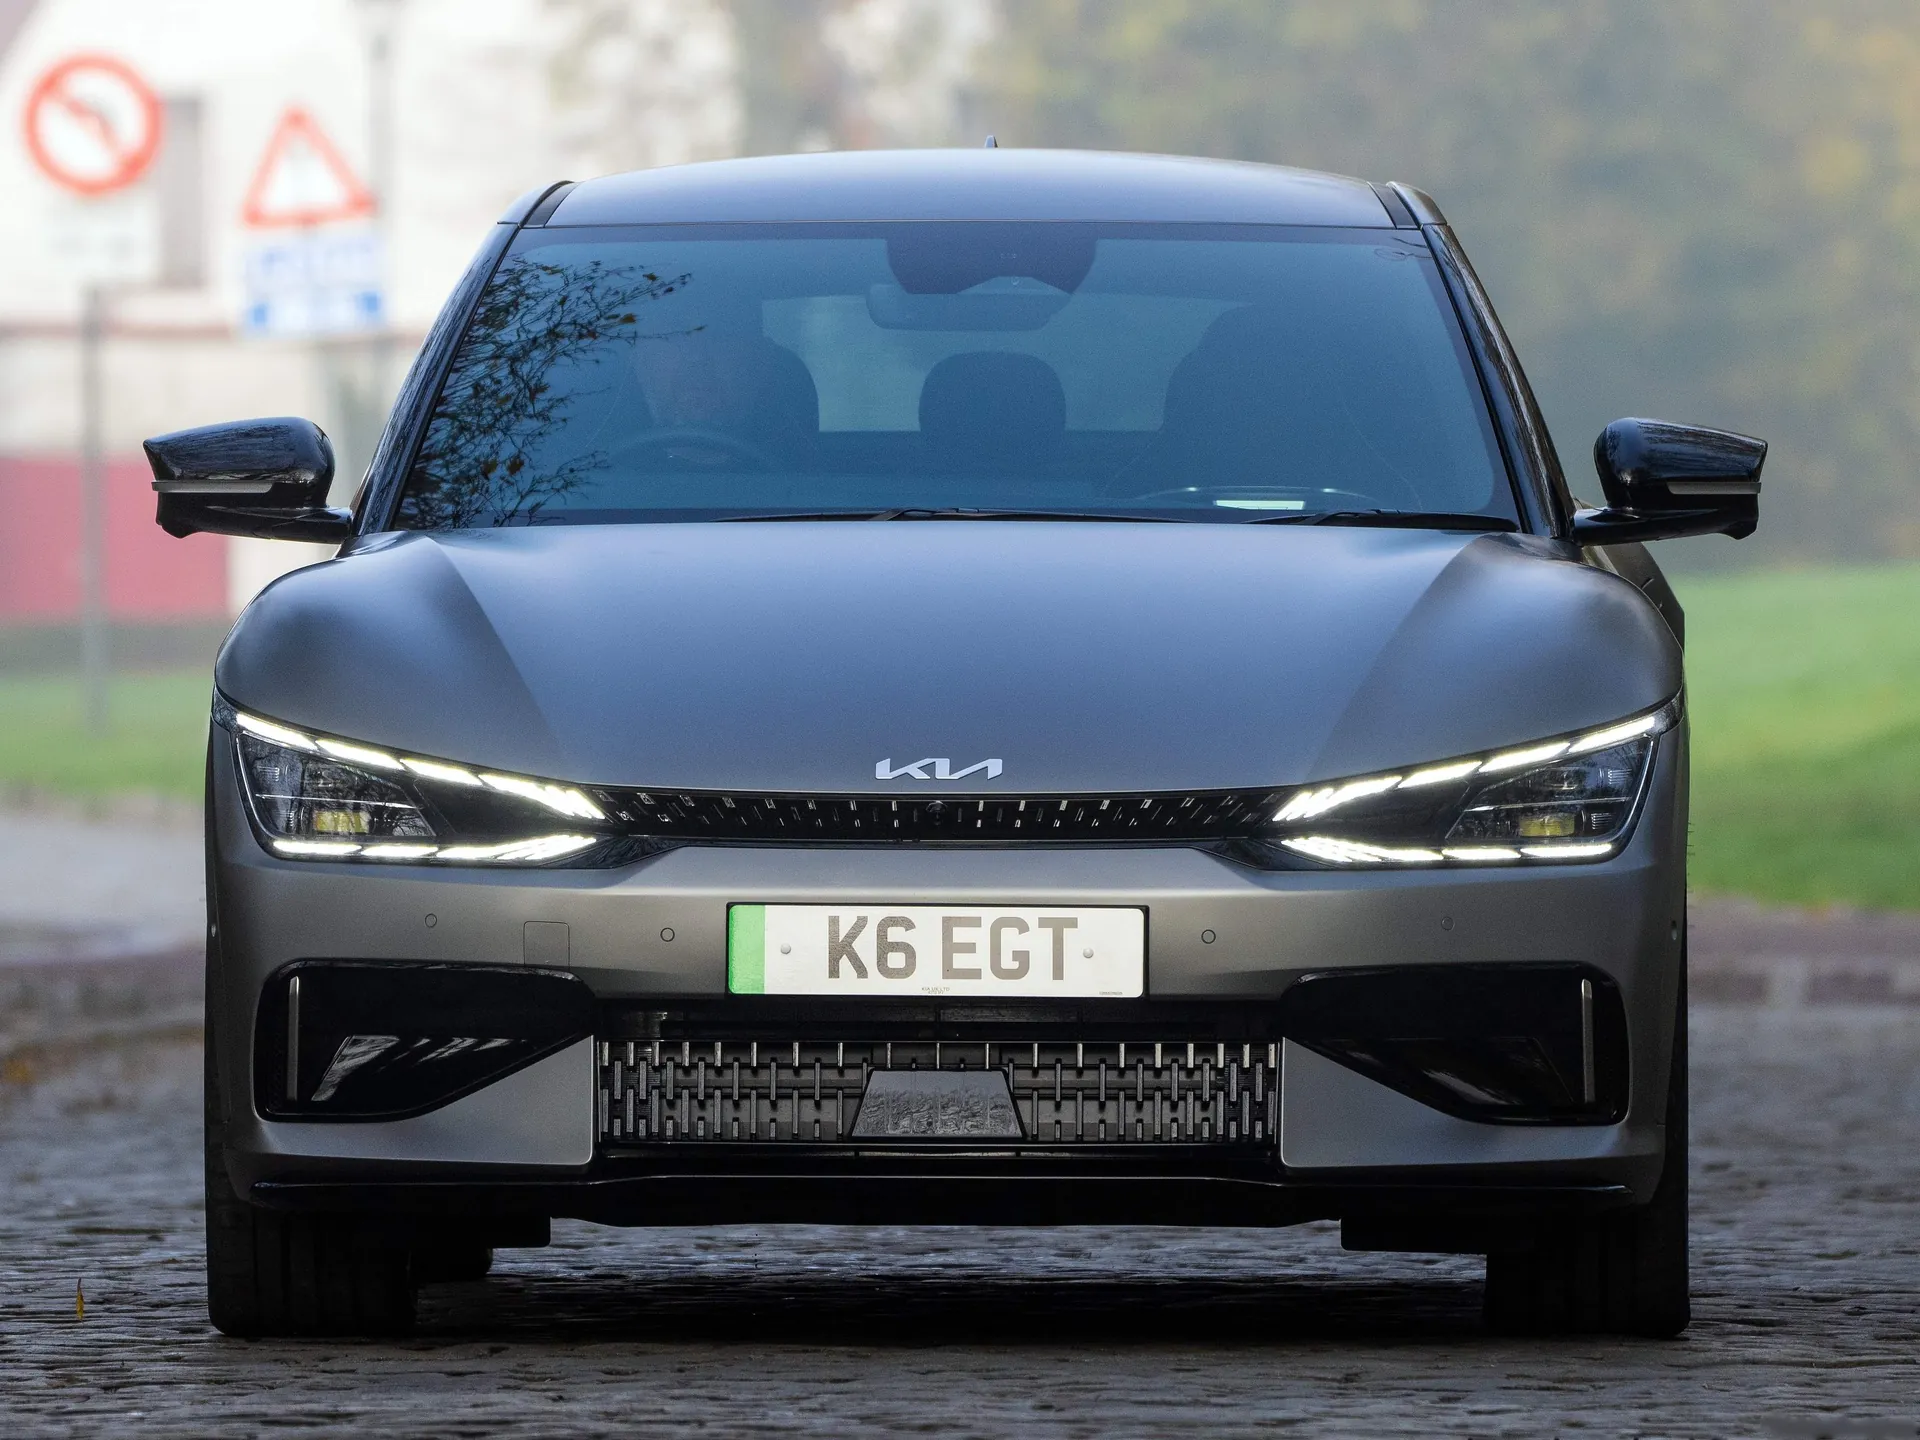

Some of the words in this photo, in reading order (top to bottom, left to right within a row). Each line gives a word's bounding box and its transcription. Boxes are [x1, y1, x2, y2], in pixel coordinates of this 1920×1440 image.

[875, 758, 1003, 780] KIA
[828, 915, 917, 979] K6
[941, 916, 1079, 980] EGT
